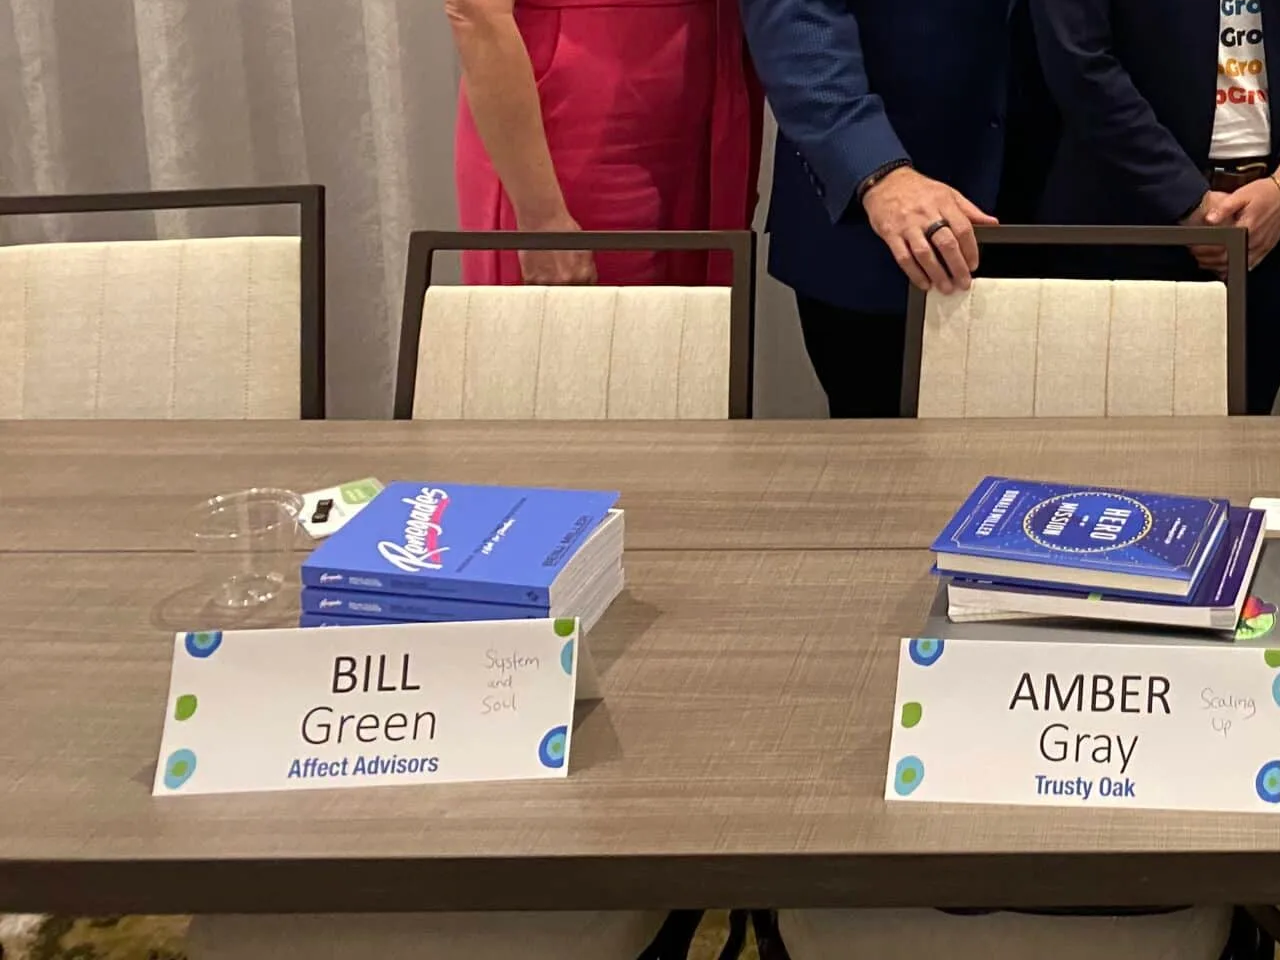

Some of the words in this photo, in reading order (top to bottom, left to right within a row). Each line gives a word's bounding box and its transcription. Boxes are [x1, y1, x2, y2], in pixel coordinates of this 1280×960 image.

[1042, 502, 1079, 536] MISSION
[1090, 508, 1132, 541] HERO
[332, 653, 421, 694] BILL
[484, 648, 540, 675] System
[487, 675, 512, 688] and
[1008, 672, 1172, 715] AMBER
[481, 693, 517, 715] Soul
[1200, 686, 1257, 720] Scaling
[302, 706, 437, 744] Green
[1212, 717, 1232, 738] Up
[1039, 723, 1138, 773] Gray
[287, 757, 349, 779] Affect
[353, 754, 439, 776] Advisors
[1035, 775, 1093, 801] Trusty
[1099, 777, 1136, 798] Oak
